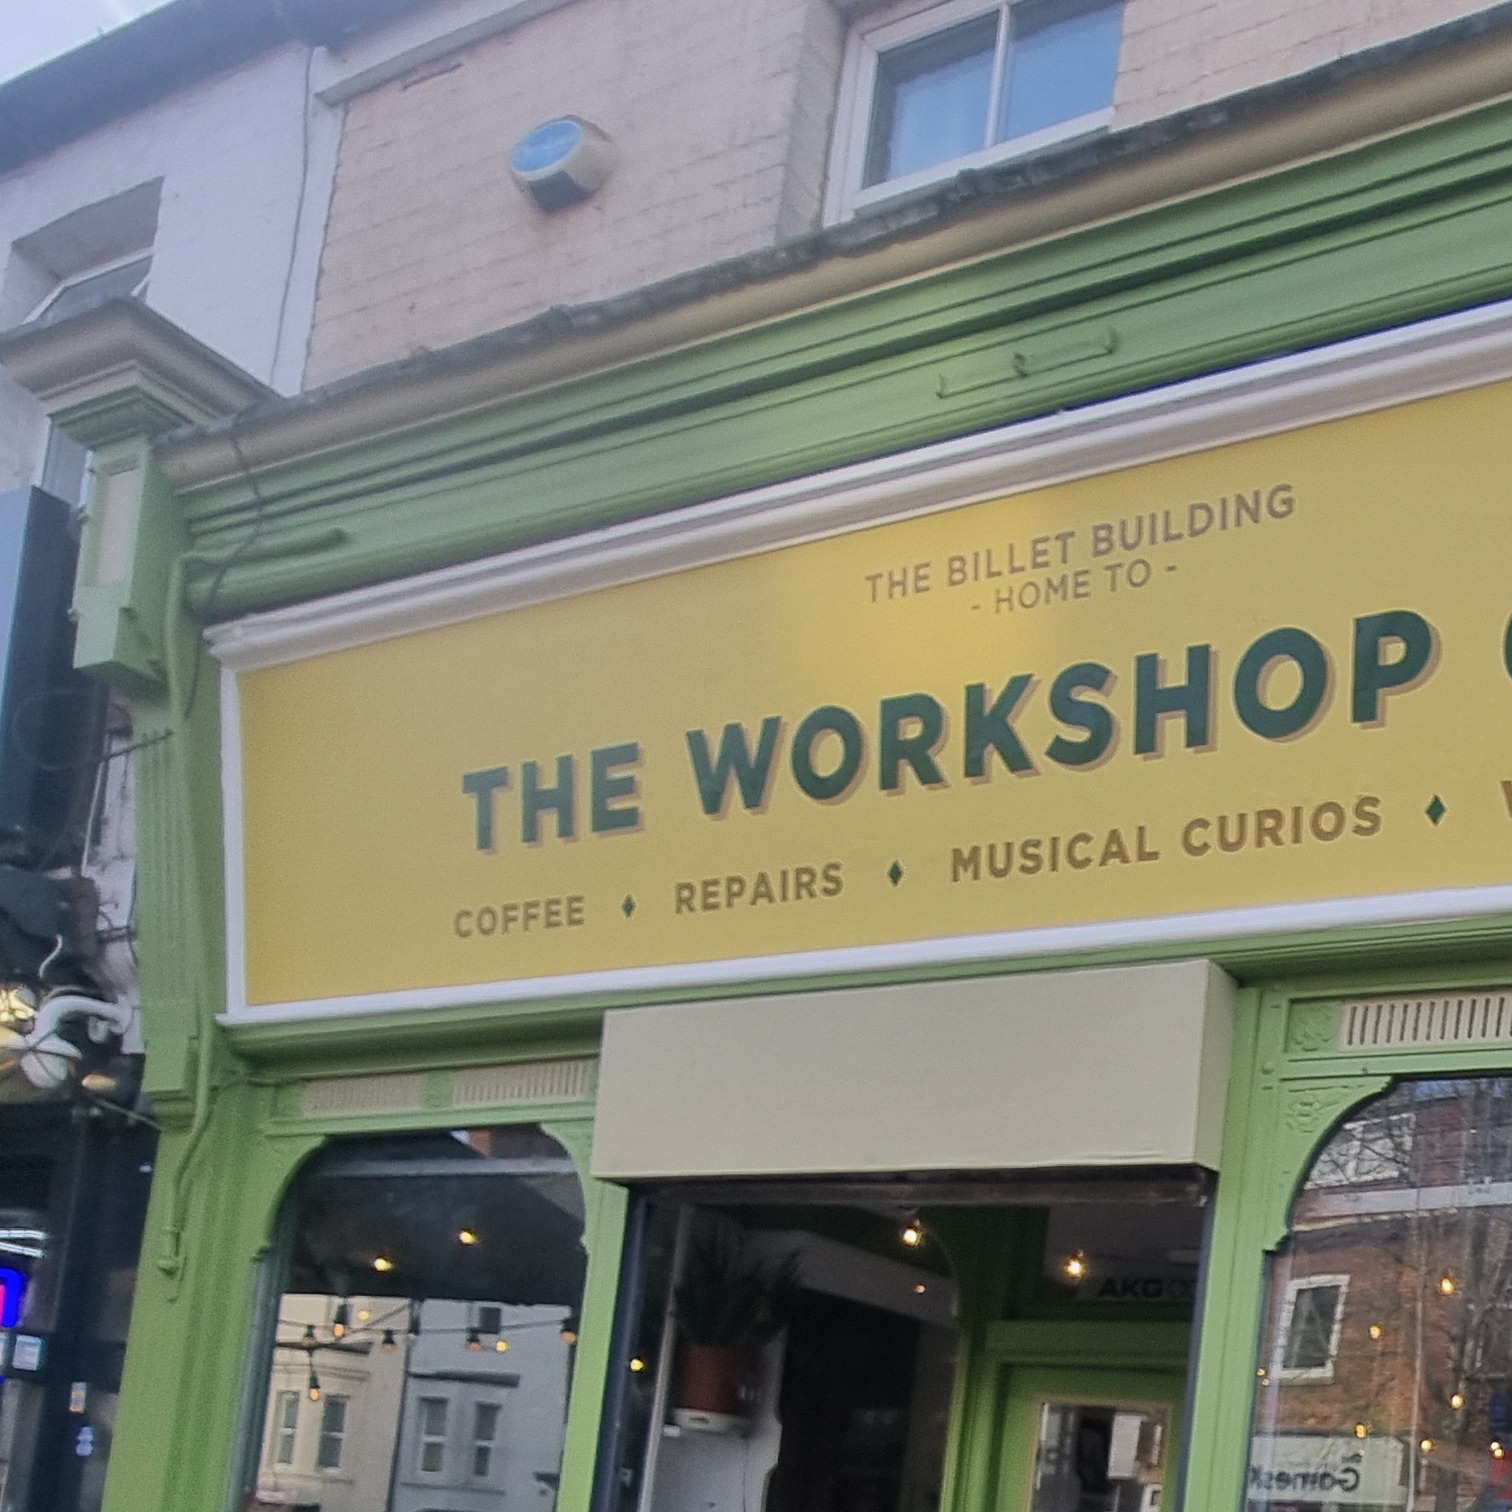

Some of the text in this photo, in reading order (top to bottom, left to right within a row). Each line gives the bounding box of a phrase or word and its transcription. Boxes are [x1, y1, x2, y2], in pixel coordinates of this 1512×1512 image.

[865, 482, 1295, 604] THE BILLET BUILDING
[994, 570, 1093, 616] HOME
[1104, 557, 1153, 593] TO
[461, 740, 645, 855] THE
[685, 609, 1442, 819] WORKSHOP
[453, 894, 586, 938] COFFEE
[673, 863, 844, 914] REPAIRS
[950, 824, 1160, 883] MUSICAL
[1181, 795, 1382, 858] CURIOS
